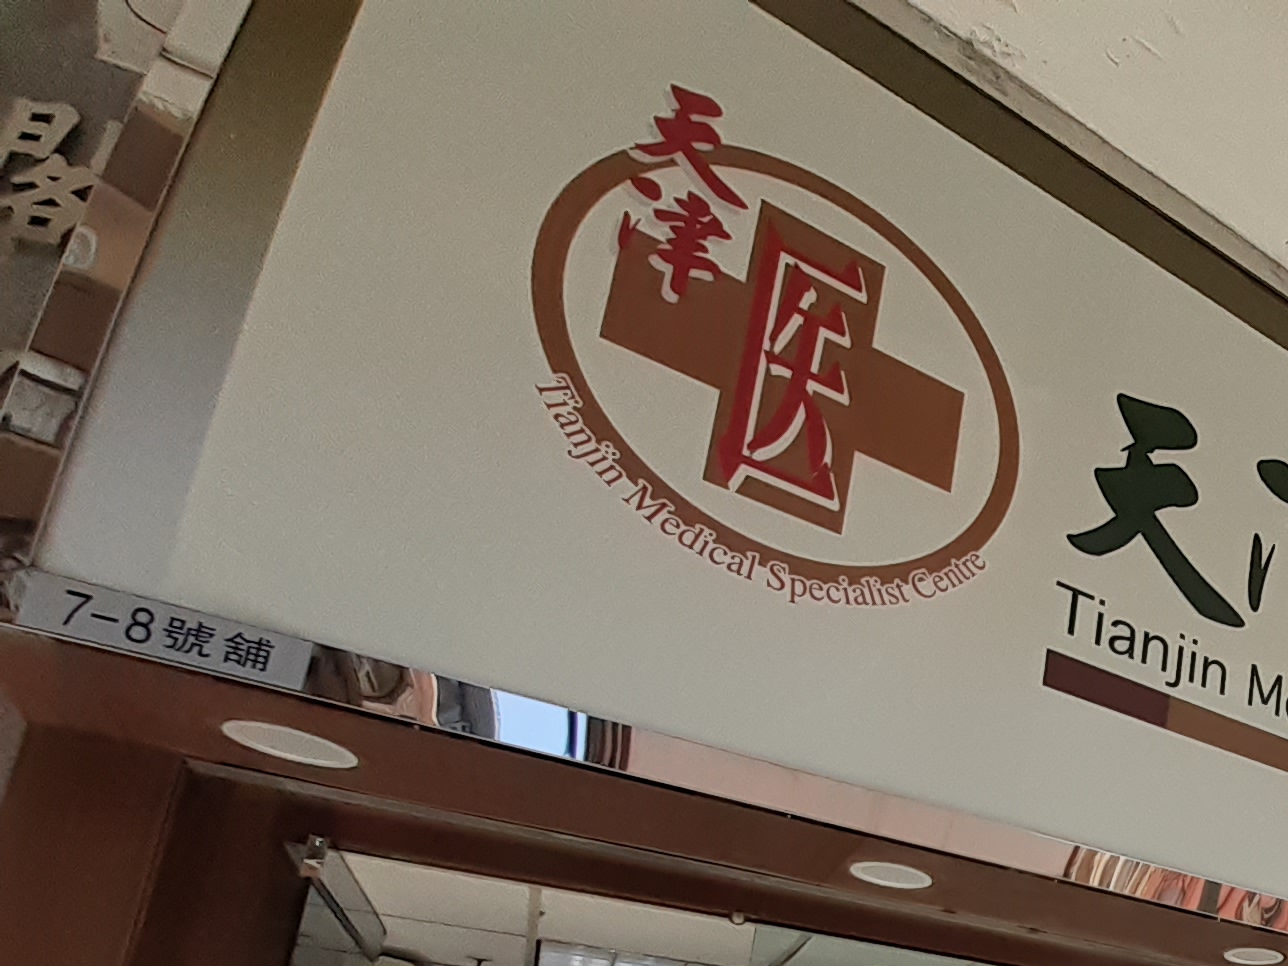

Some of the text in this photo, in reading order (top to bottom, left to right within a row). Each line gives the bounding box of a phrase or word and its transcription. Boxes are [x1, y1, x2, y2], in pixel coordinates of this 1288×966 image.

[616, 84, 748, 300] 天津
[535, 374, 986, 606] Tianjin Medical Specialist Centre
[1056, 581, 1228, 696] Tianjin
